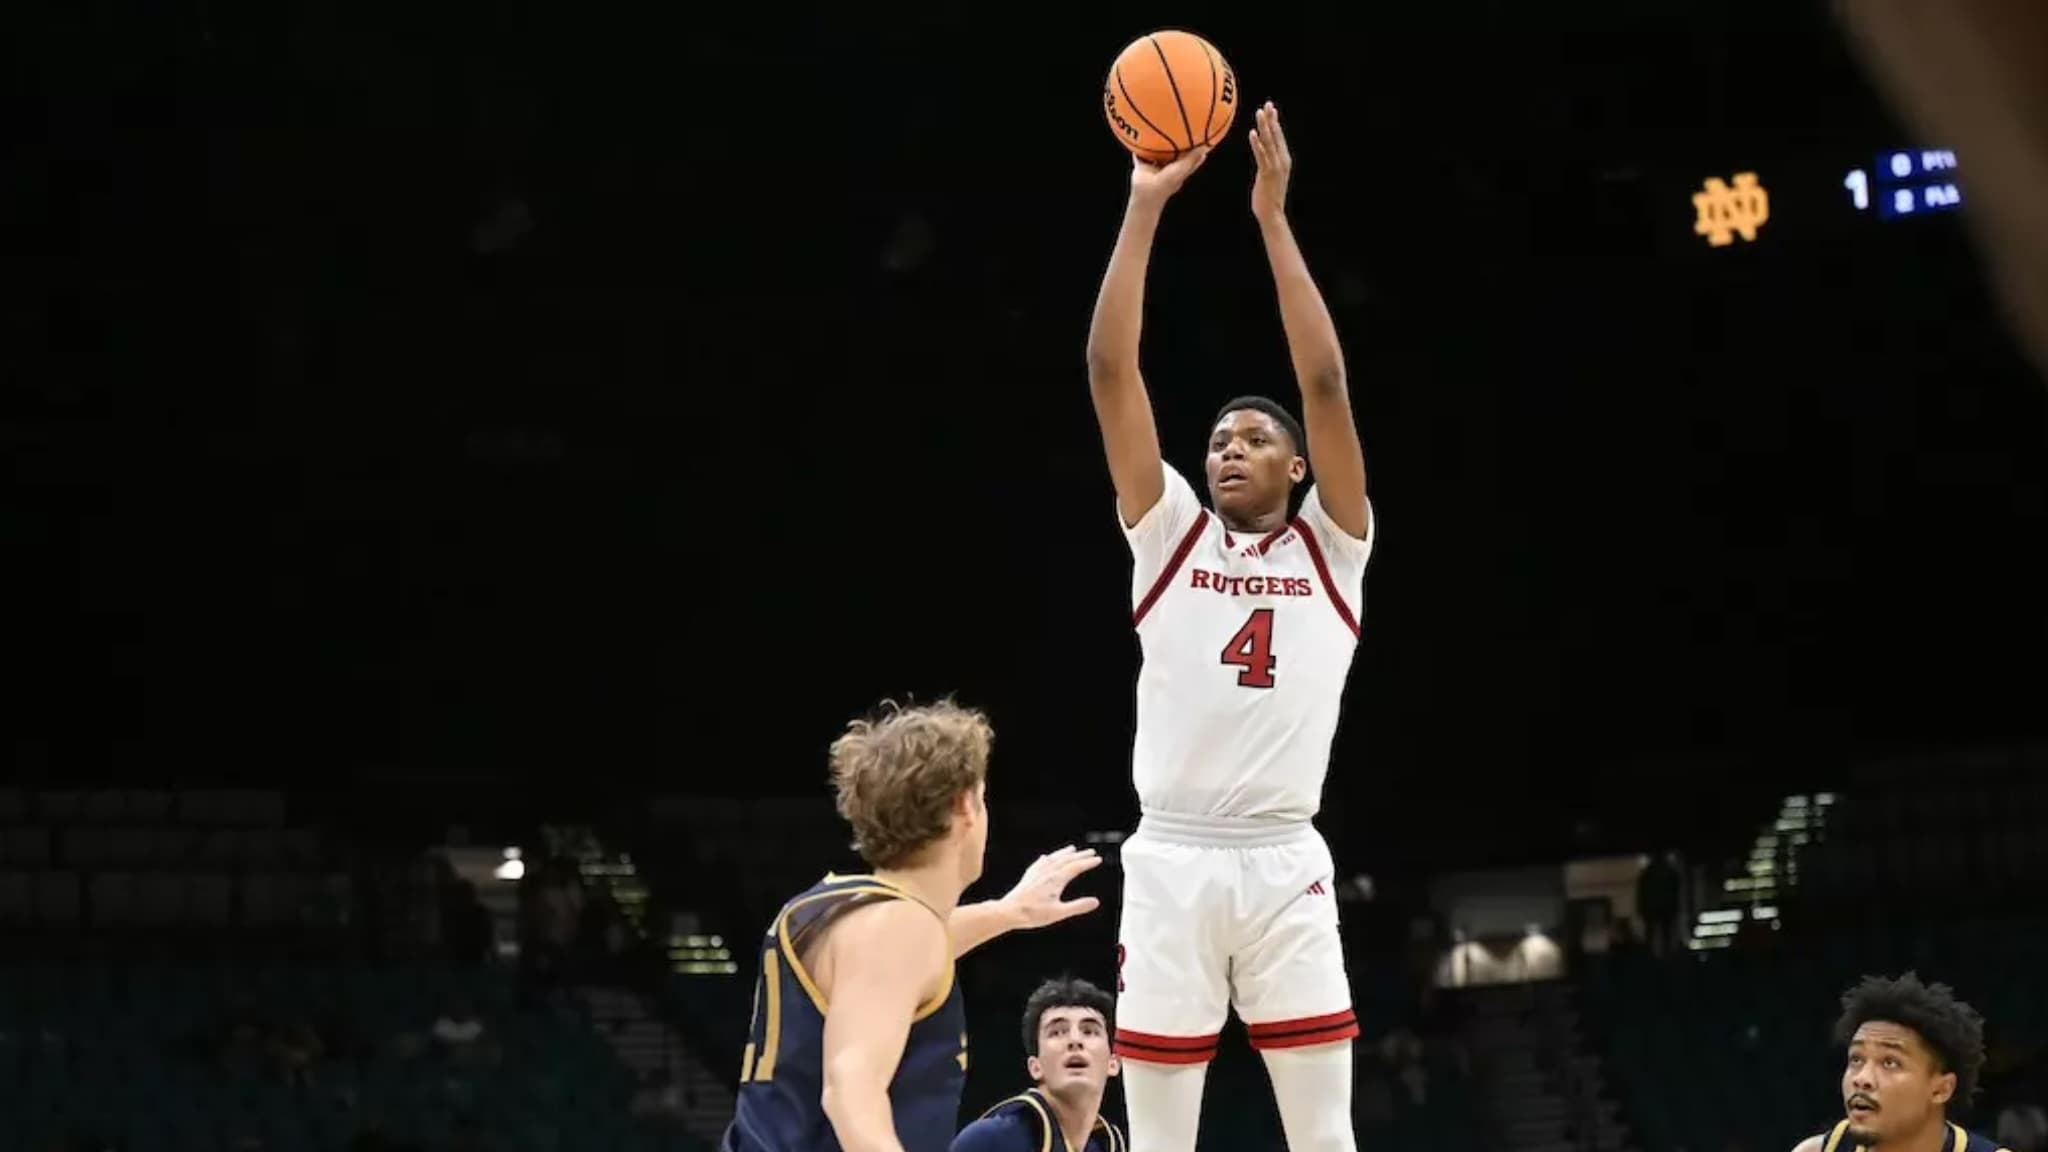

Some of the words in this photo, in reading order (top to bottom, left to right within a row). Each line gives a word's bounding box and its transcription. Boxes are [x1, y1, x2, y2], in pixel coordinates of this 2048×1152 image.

[1844, 169, 1869, 210] 1
[1190, 568, 1313, 597] RUTGERS
[1220, 608, 1277, 689] 4
